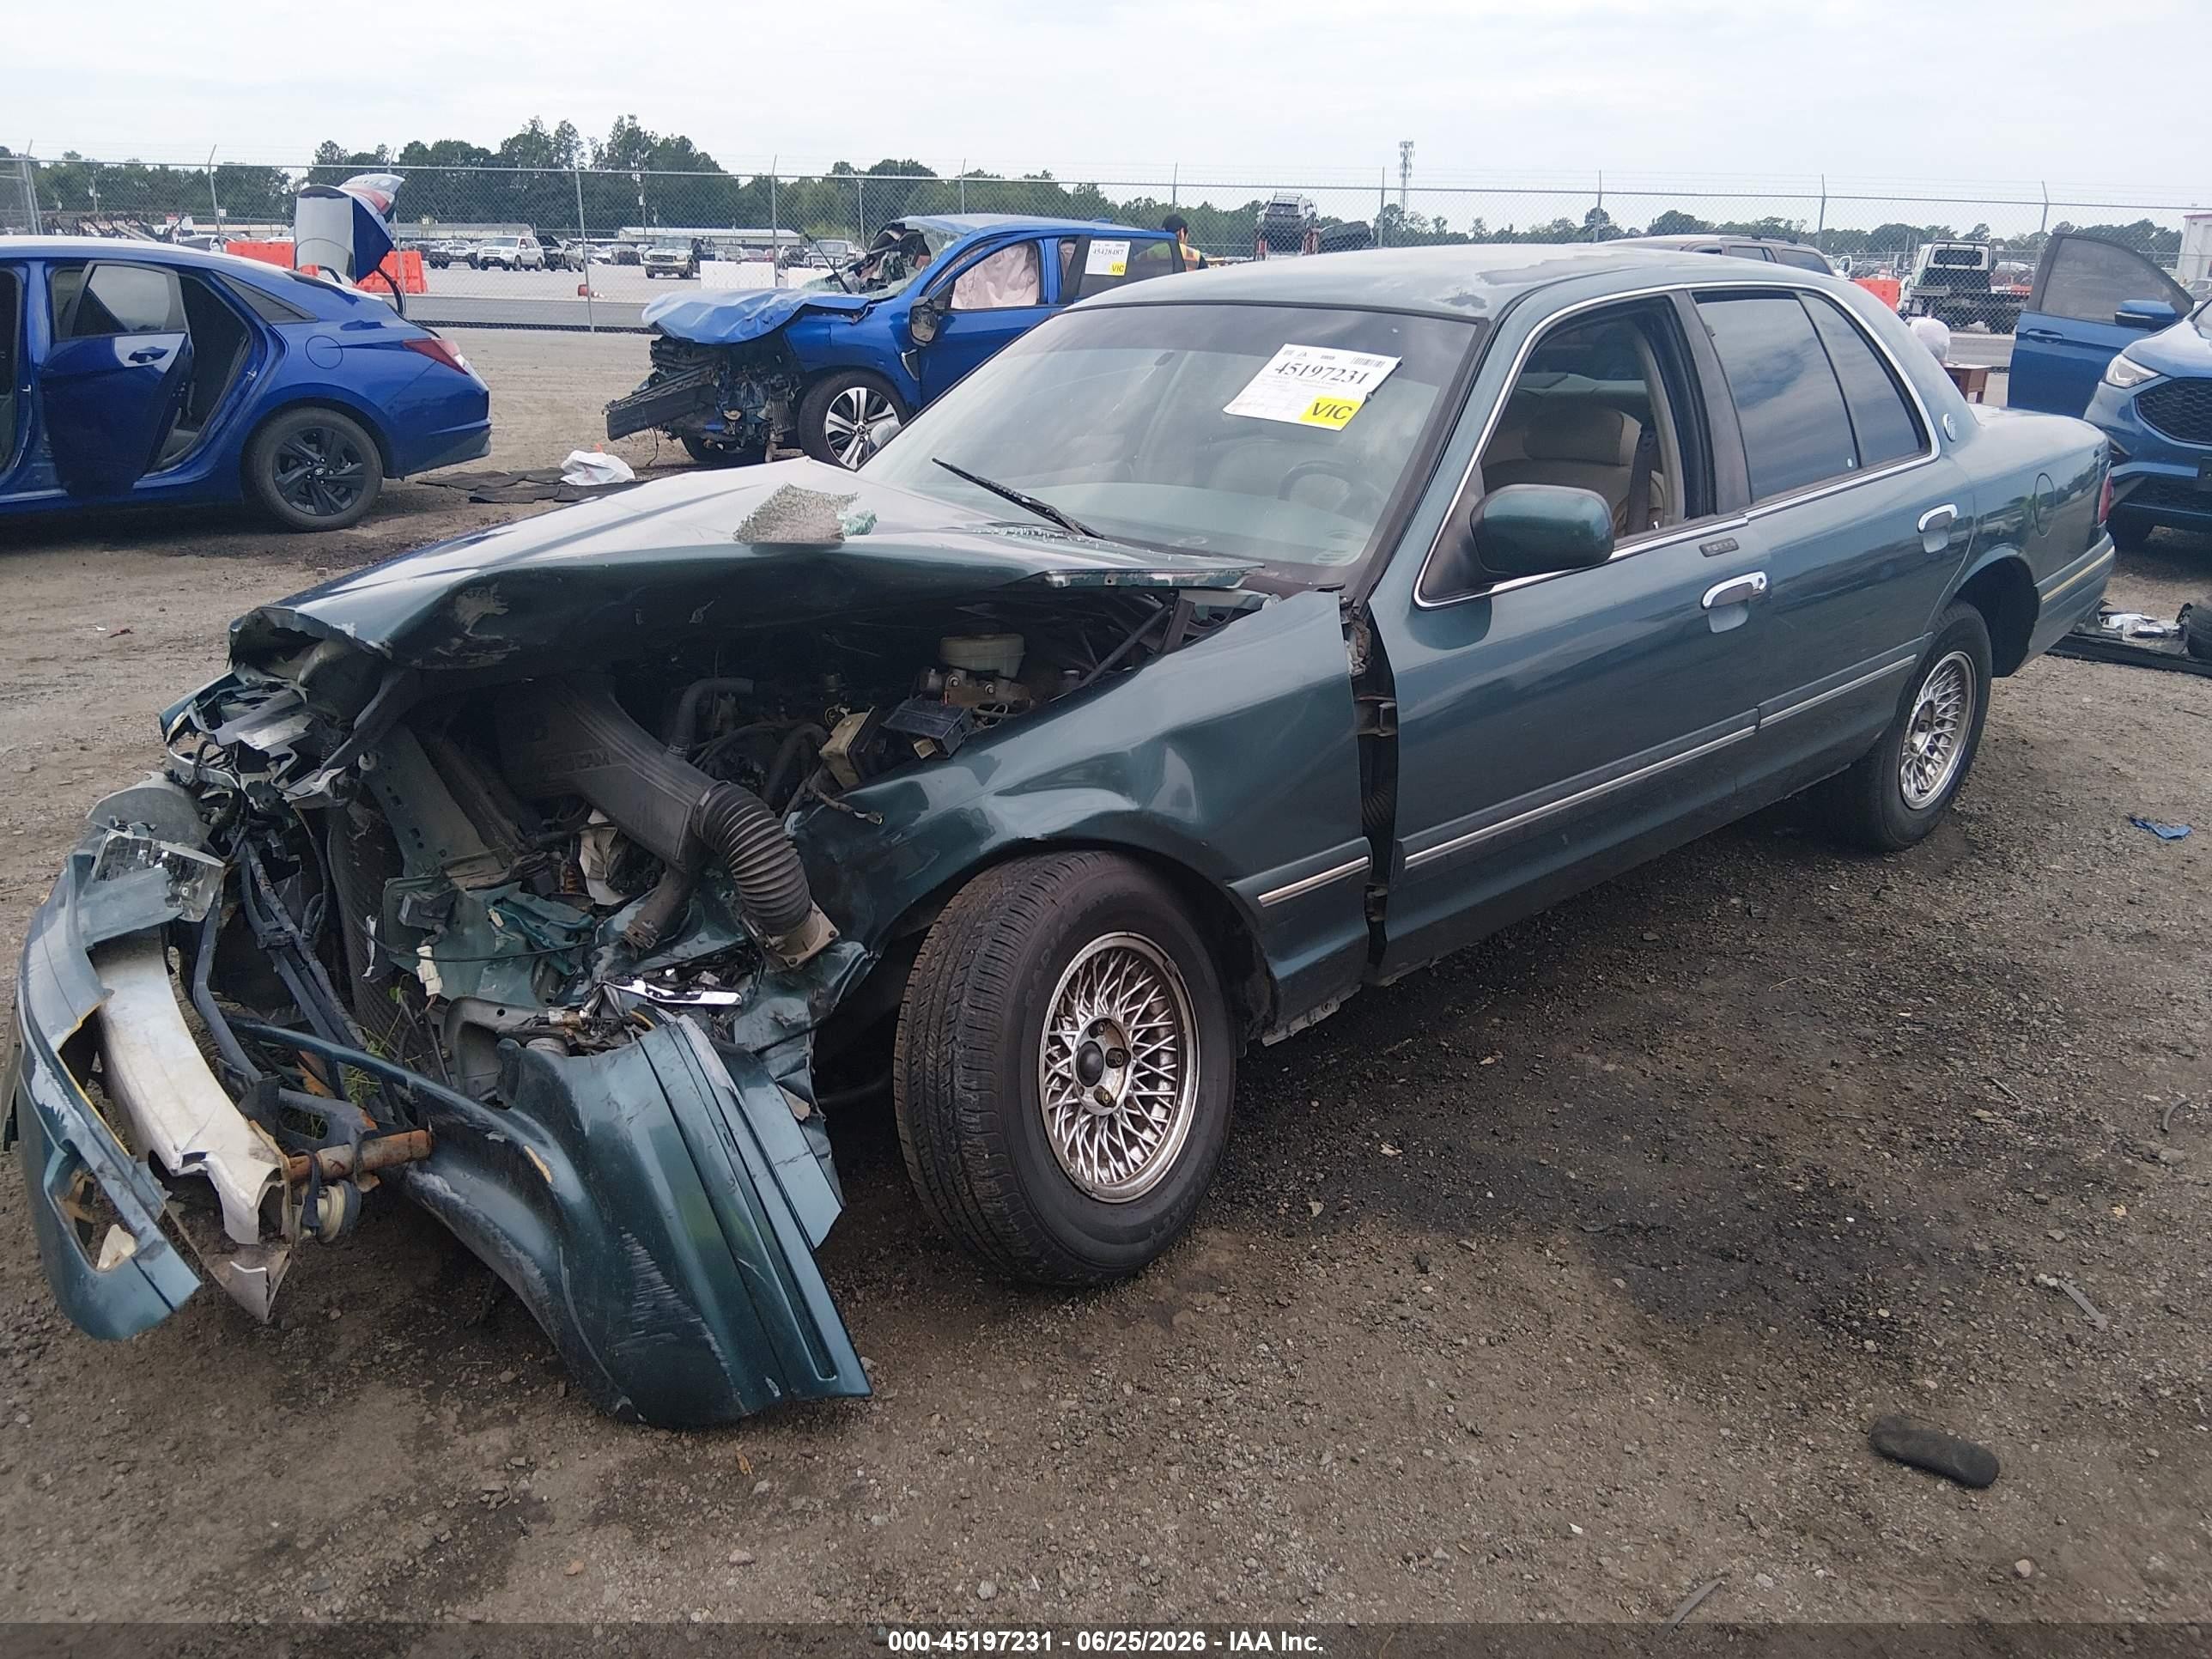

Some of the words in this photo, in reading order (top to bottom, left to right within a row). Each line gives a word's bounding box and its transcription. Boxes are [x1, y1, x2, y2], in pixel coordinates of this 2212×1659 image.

[1112, 264, 1124, 272] VIC
[1275, 361, 1370, 385] 45197231
[1311, 402, 1353, 420] VIC
